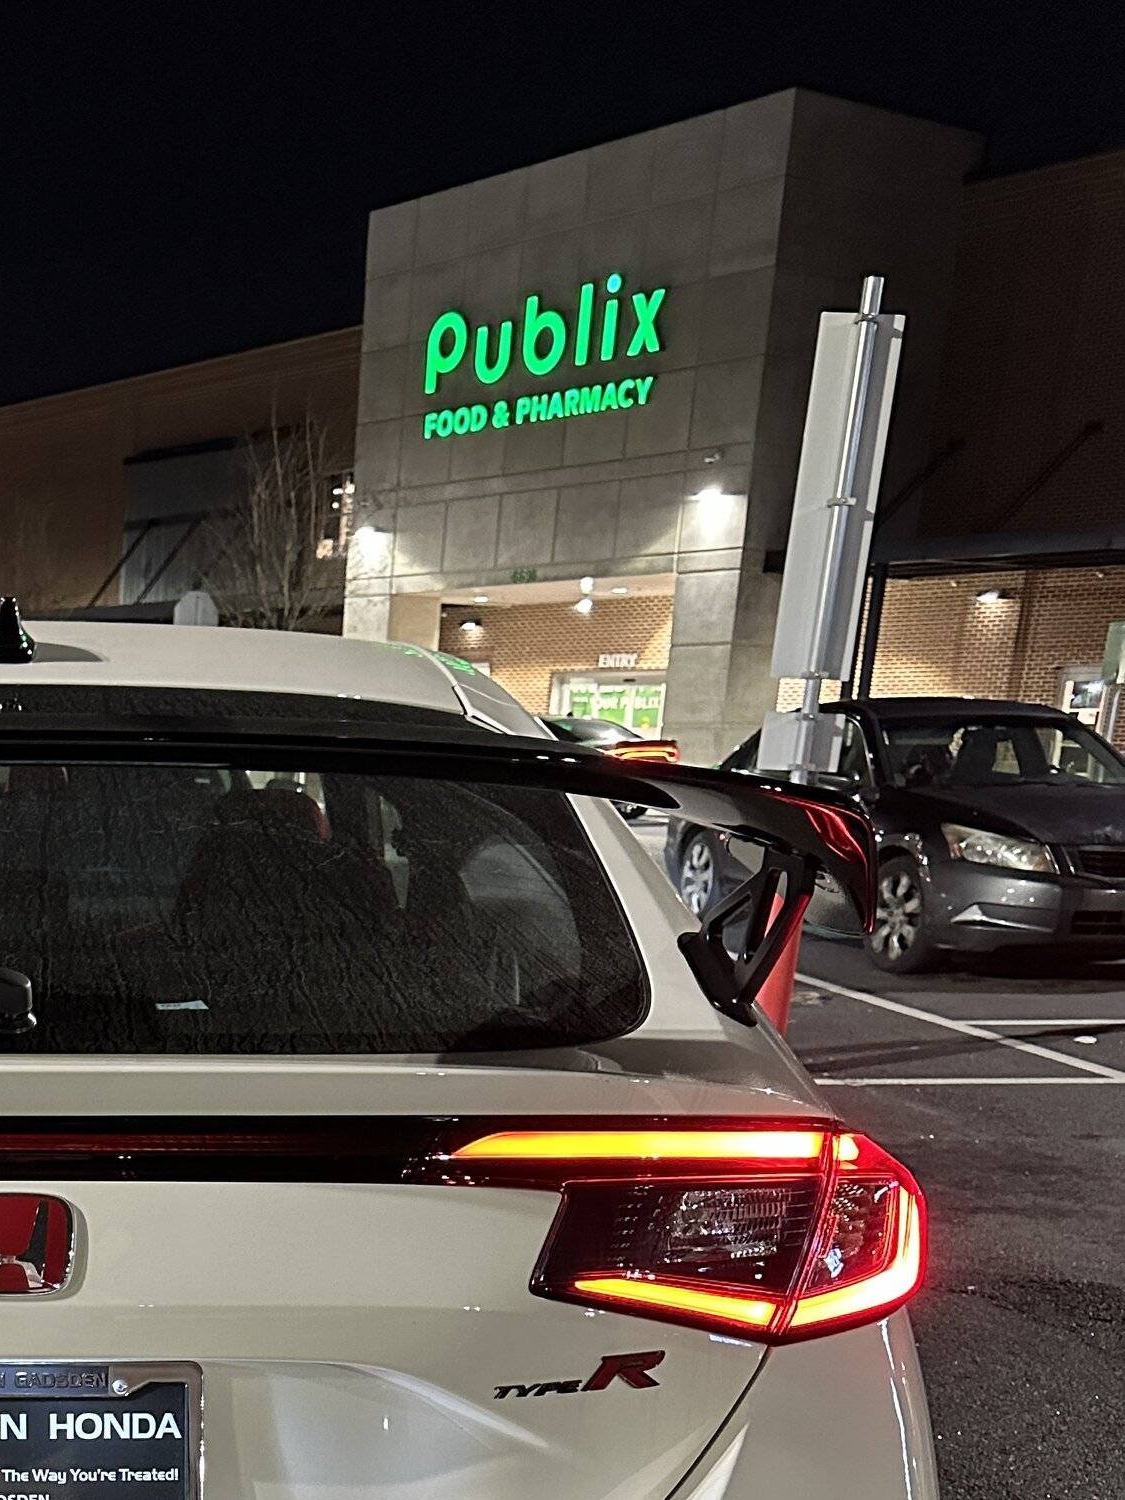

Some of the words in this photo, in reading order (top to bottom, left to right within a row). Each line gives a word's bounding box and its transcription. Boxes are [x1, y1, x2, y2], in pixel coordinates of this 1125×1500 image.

[424, 272, 667, 395] Publix
[423, 404, 489, 440] FOOD
[491, 400, 510, 430] &
[515, 376, 654, 425] PHARMACY
[598, 653, 637, 668] ENTRY
[14, 1371, 108, 1389] GADSDEN
[493, 1379, 583, 1399] TYPE
[48, 1411, 183, 1441] HONDA
[1, 1468, 29, 1483] The
[31, 1468, 67, 1485] Way
[69, 1468, 117, 1482] You're
[118, 1467, 180, 1482] Treated!
